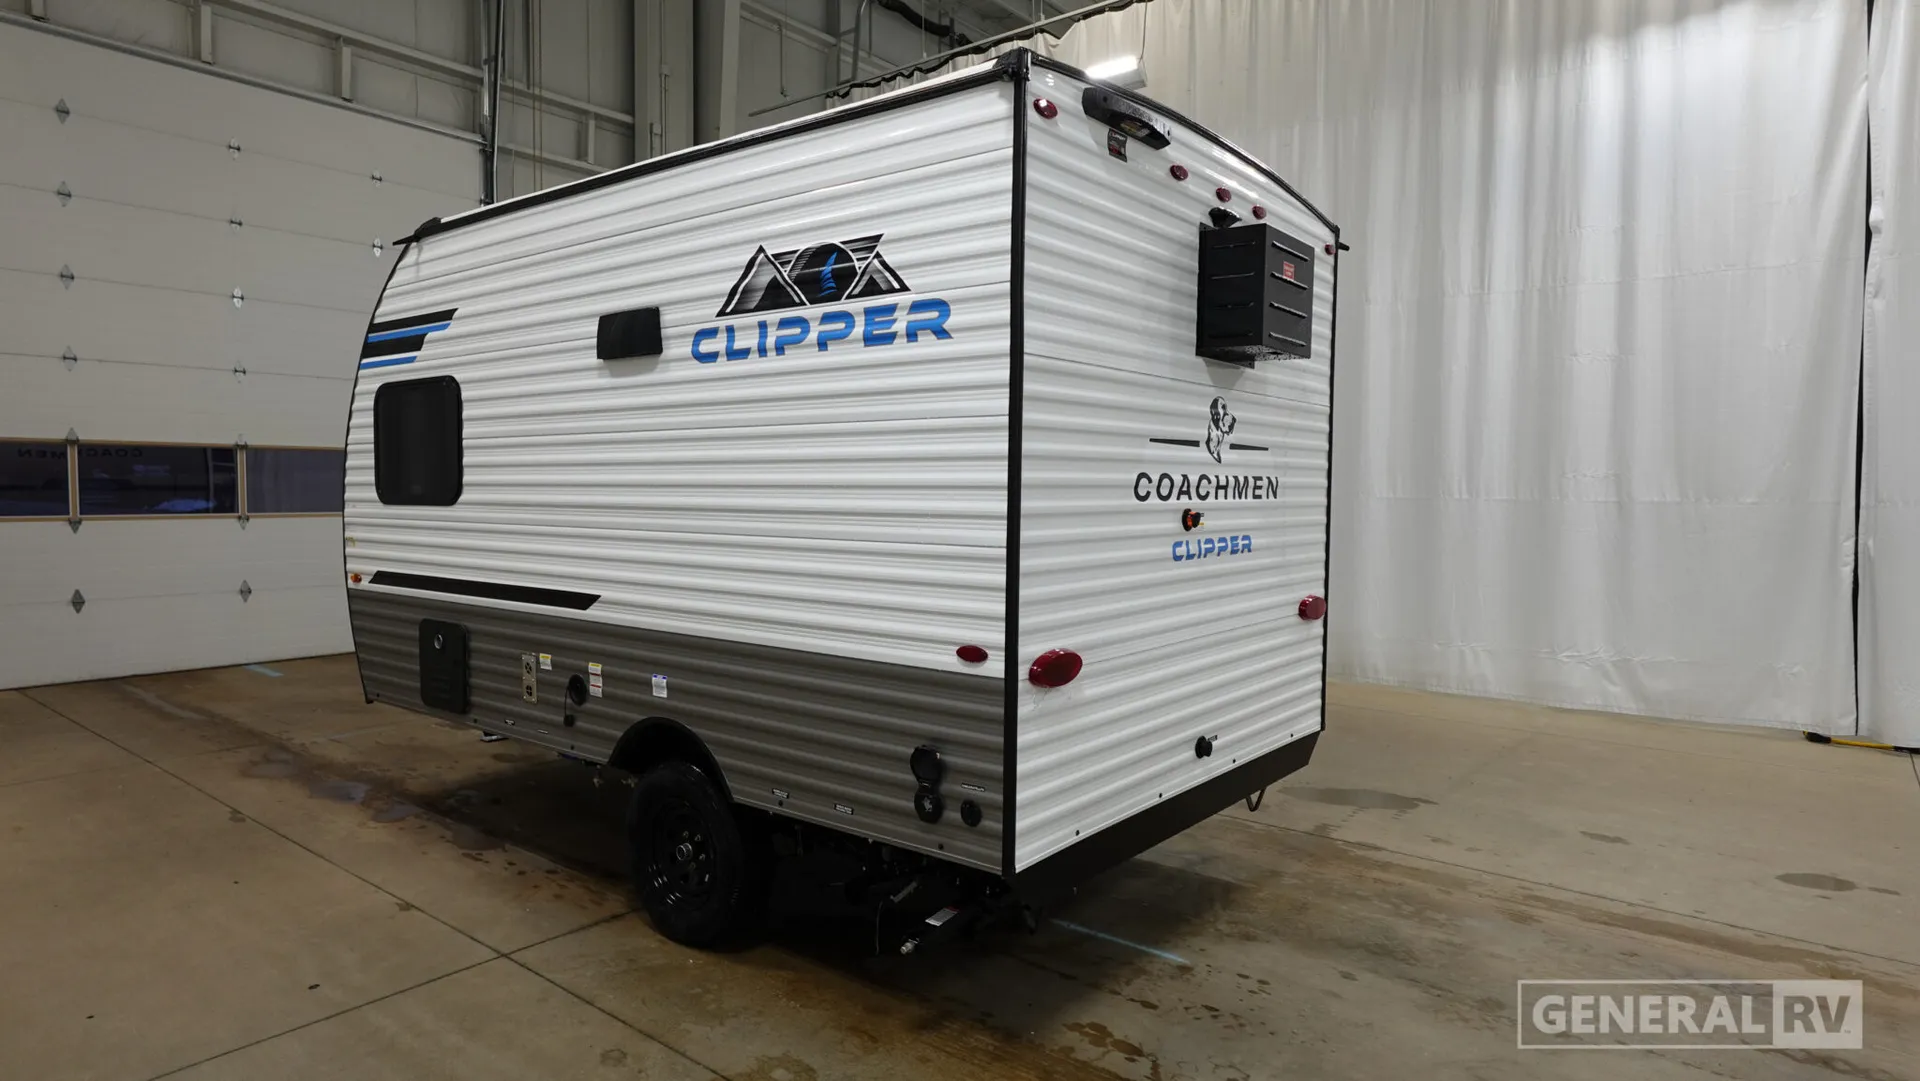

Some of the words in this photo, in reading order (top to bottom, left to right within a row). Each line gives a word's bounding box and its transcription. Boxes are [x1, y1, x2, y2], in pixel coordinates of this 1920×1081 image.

[691, 298, 954, 364] CLIPPER
[1133, 472, 1279, 502] COACHMEN
[1172, 535, 1253, 562] CLIPPER
